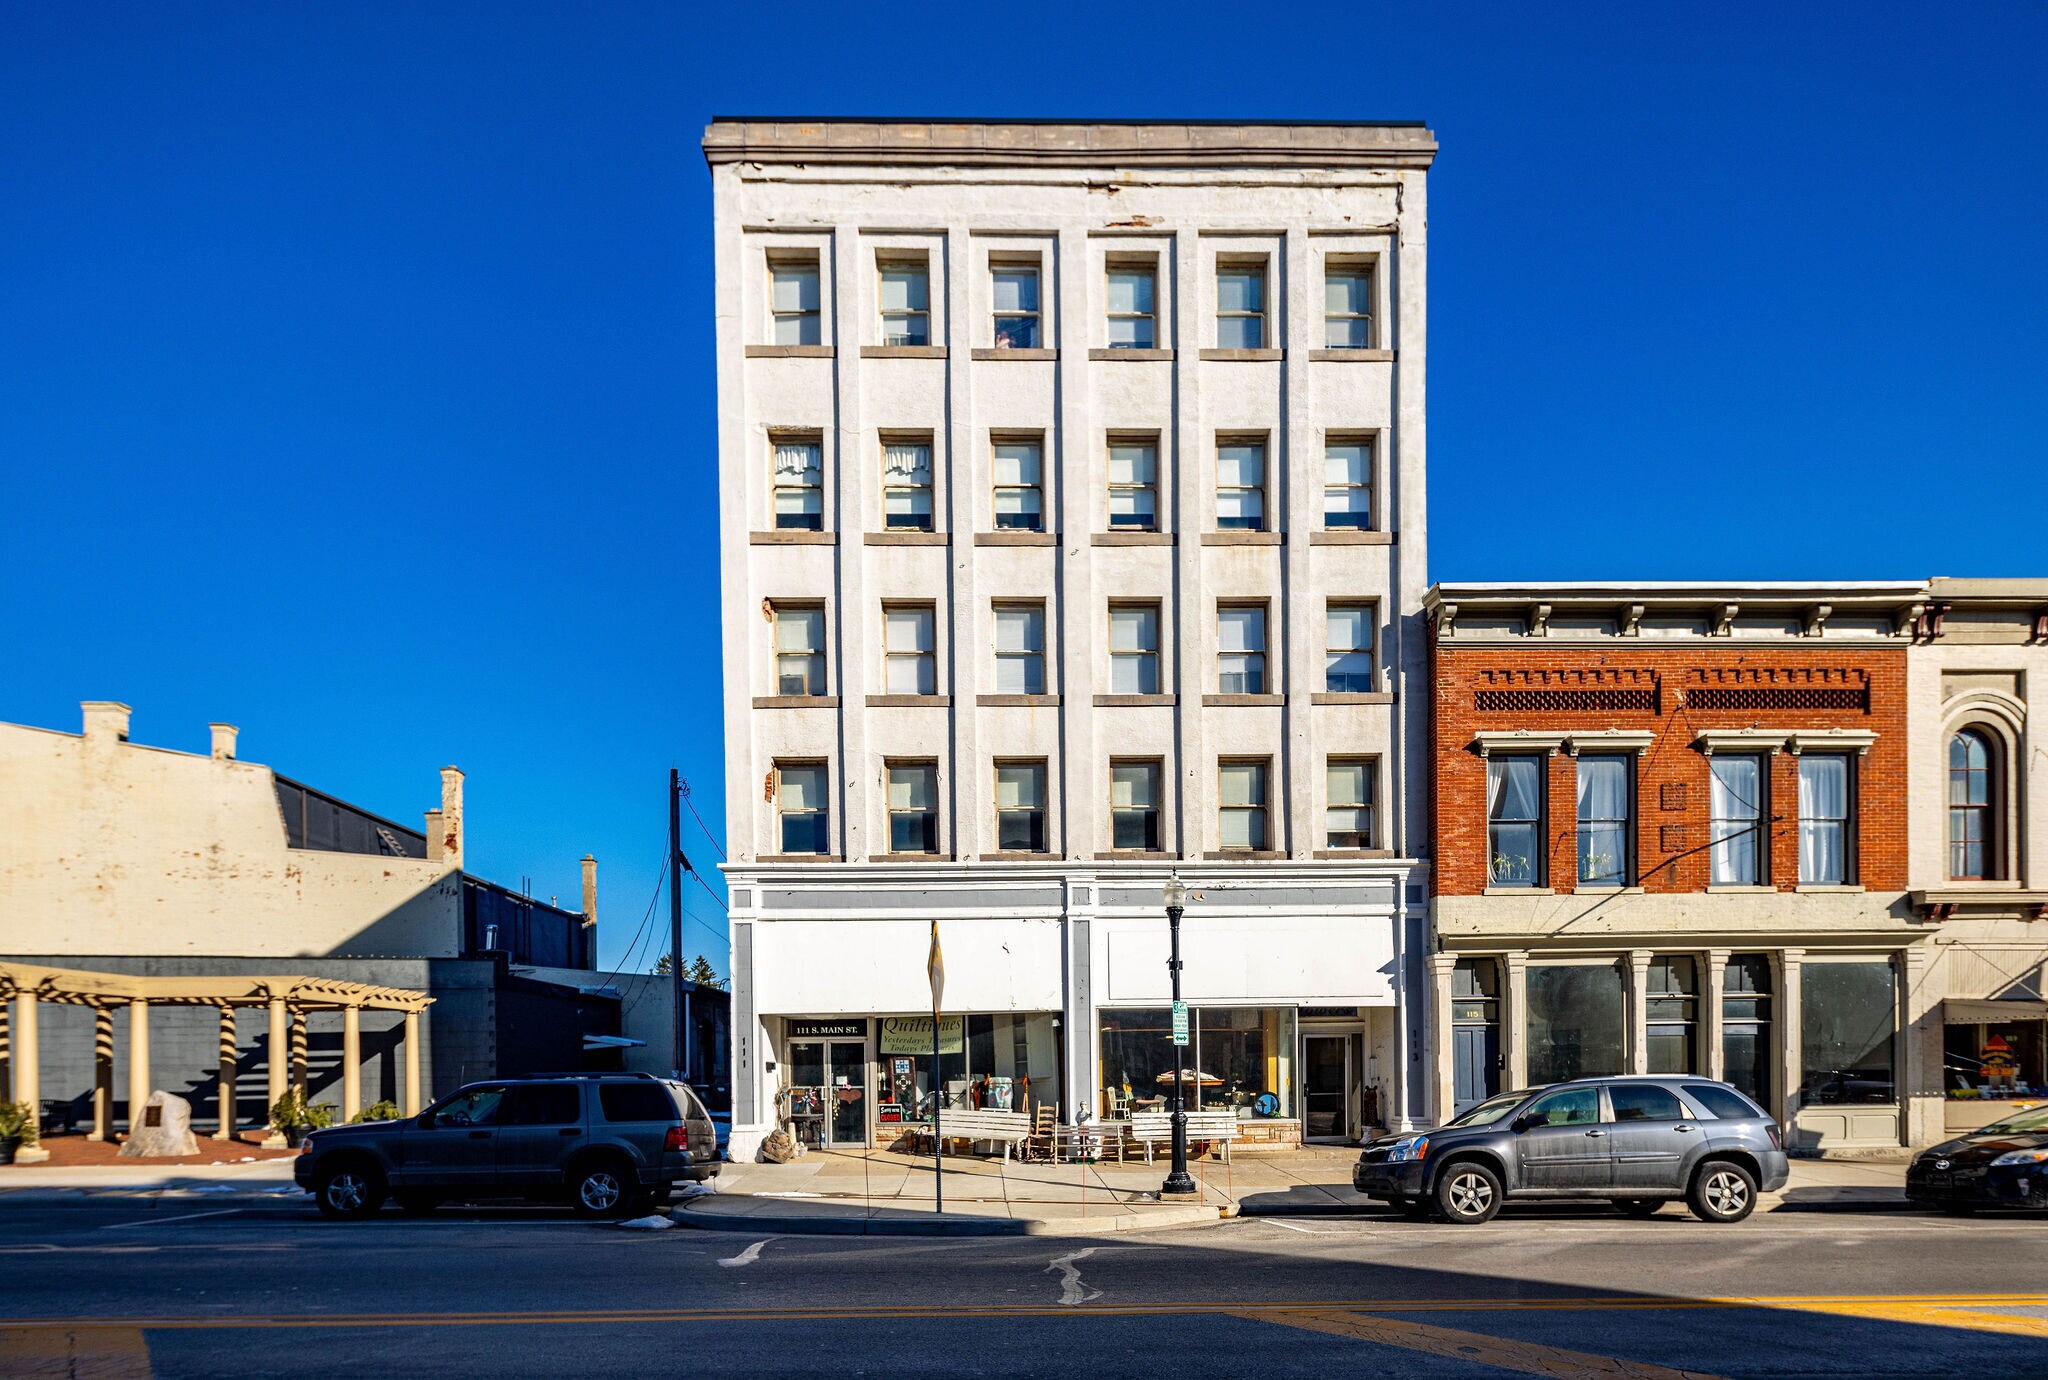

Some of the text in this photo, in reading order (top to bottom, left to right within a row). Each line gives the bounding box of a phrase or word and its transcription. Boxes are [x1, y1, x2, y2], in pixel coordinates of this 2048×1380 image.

[811, 1026, 819, 1034] S.
[821, 1026, 844, 1034] MAIN
[845, 1026, 858, 1034] ST.
[884, 1035, 925, 1046] Yesterdays
[881, 1113, 901, 1121] CLOSED
